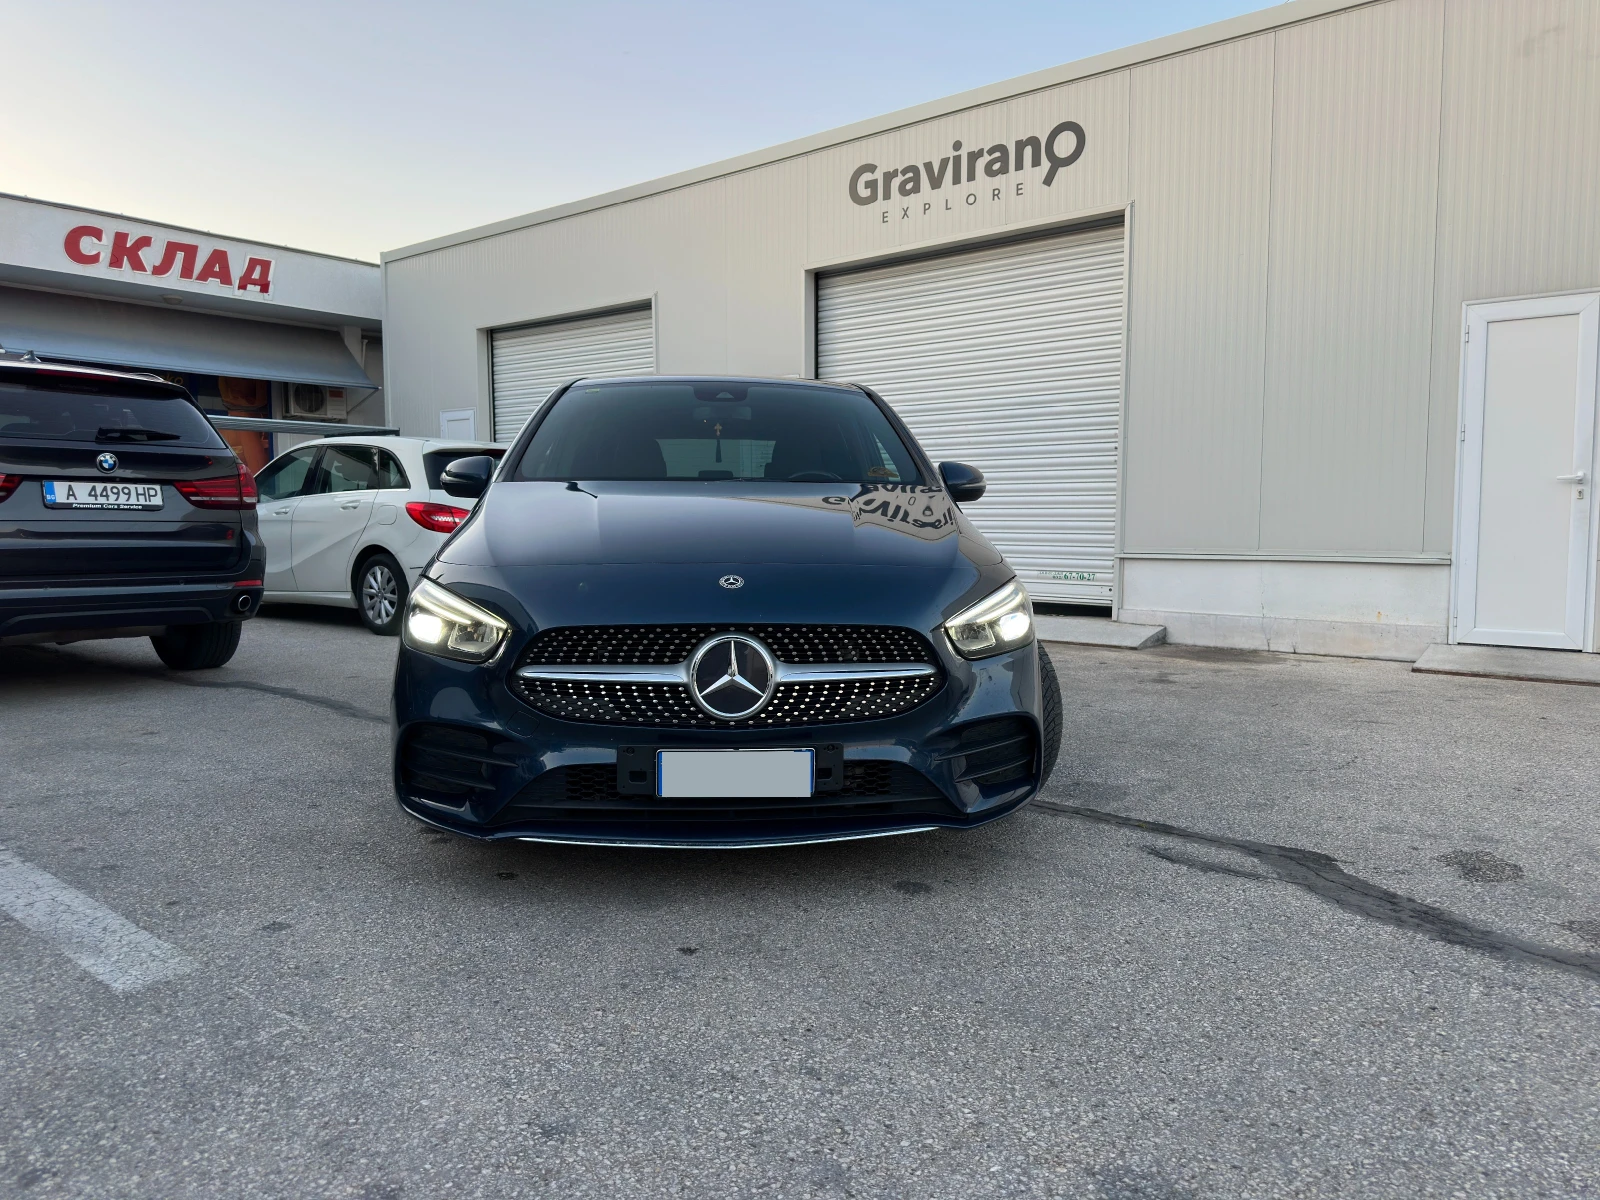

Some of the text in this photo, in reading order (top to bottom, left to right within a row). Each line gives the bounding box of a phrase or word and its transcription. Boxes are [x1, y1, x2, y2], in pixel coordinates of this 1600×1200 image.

[849, 121, 1086, 206] Gravirano
[881, 182, 1024, 223] EXPLORE
[64, 225, 272, 294] СКЛАД
[66, 484, 158, 502] A 4499 HP
